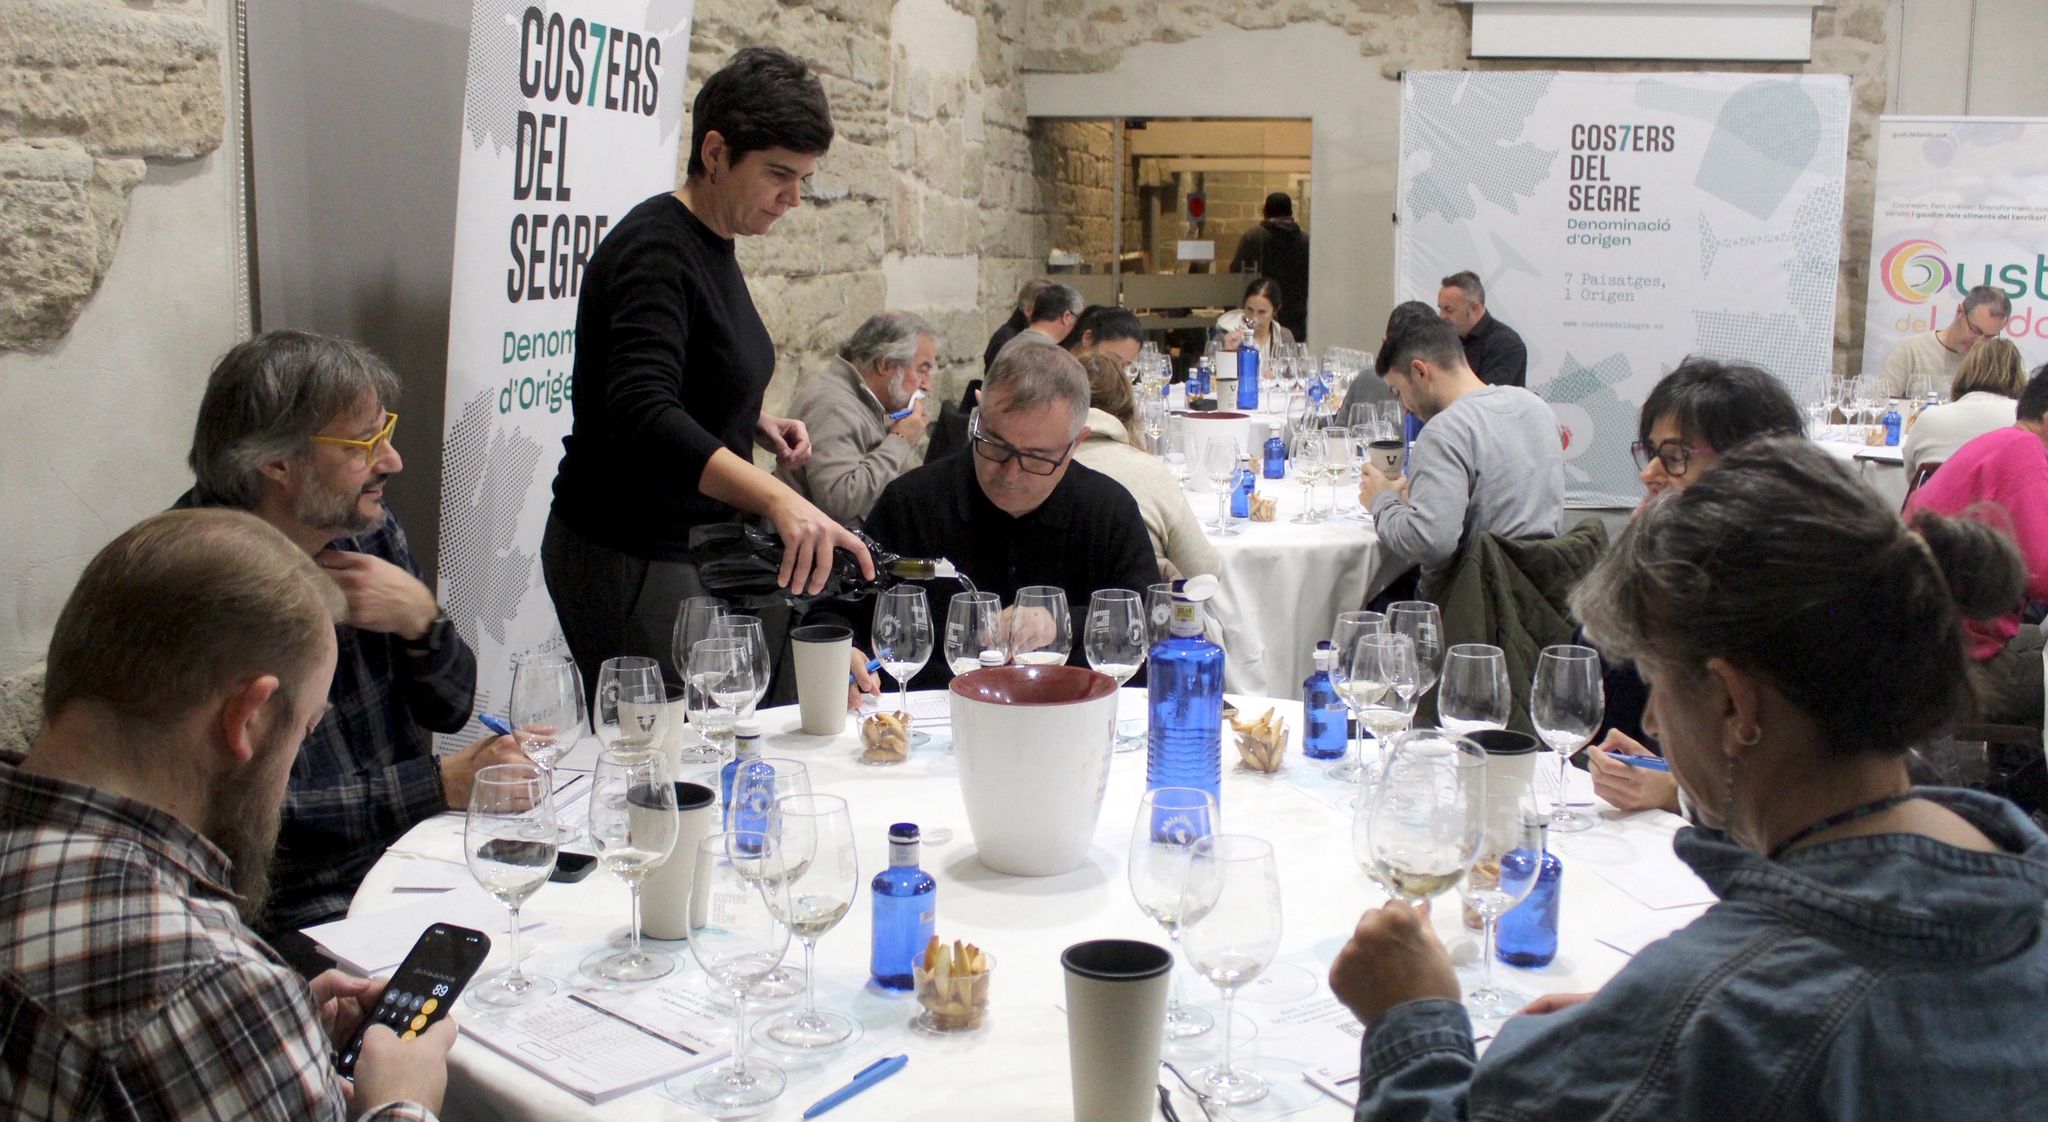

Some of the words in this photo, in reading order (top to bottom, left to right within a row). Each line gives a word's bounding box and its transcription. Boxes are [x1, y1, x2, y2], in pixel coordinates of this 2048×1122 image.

[520, 6, 661, 117] COS7ERS
[1571, 124, 1675, 152] COS7ERS
[513, 111, 571, 202] DEL
[1570, 155, 1610, 181] DEL
[1568, 185, 1641, 212] SEGRE
[1567, 218, 1671, 232] Denominació
[1566, 233, 1632, 249] d'Origen
[1564, 272, 1573, 285] 7
[1581, 273, 1666, 289] Paisatges,
[1581, 288, 1635, 304] Origen
[432, 984, 448, 997] 89
